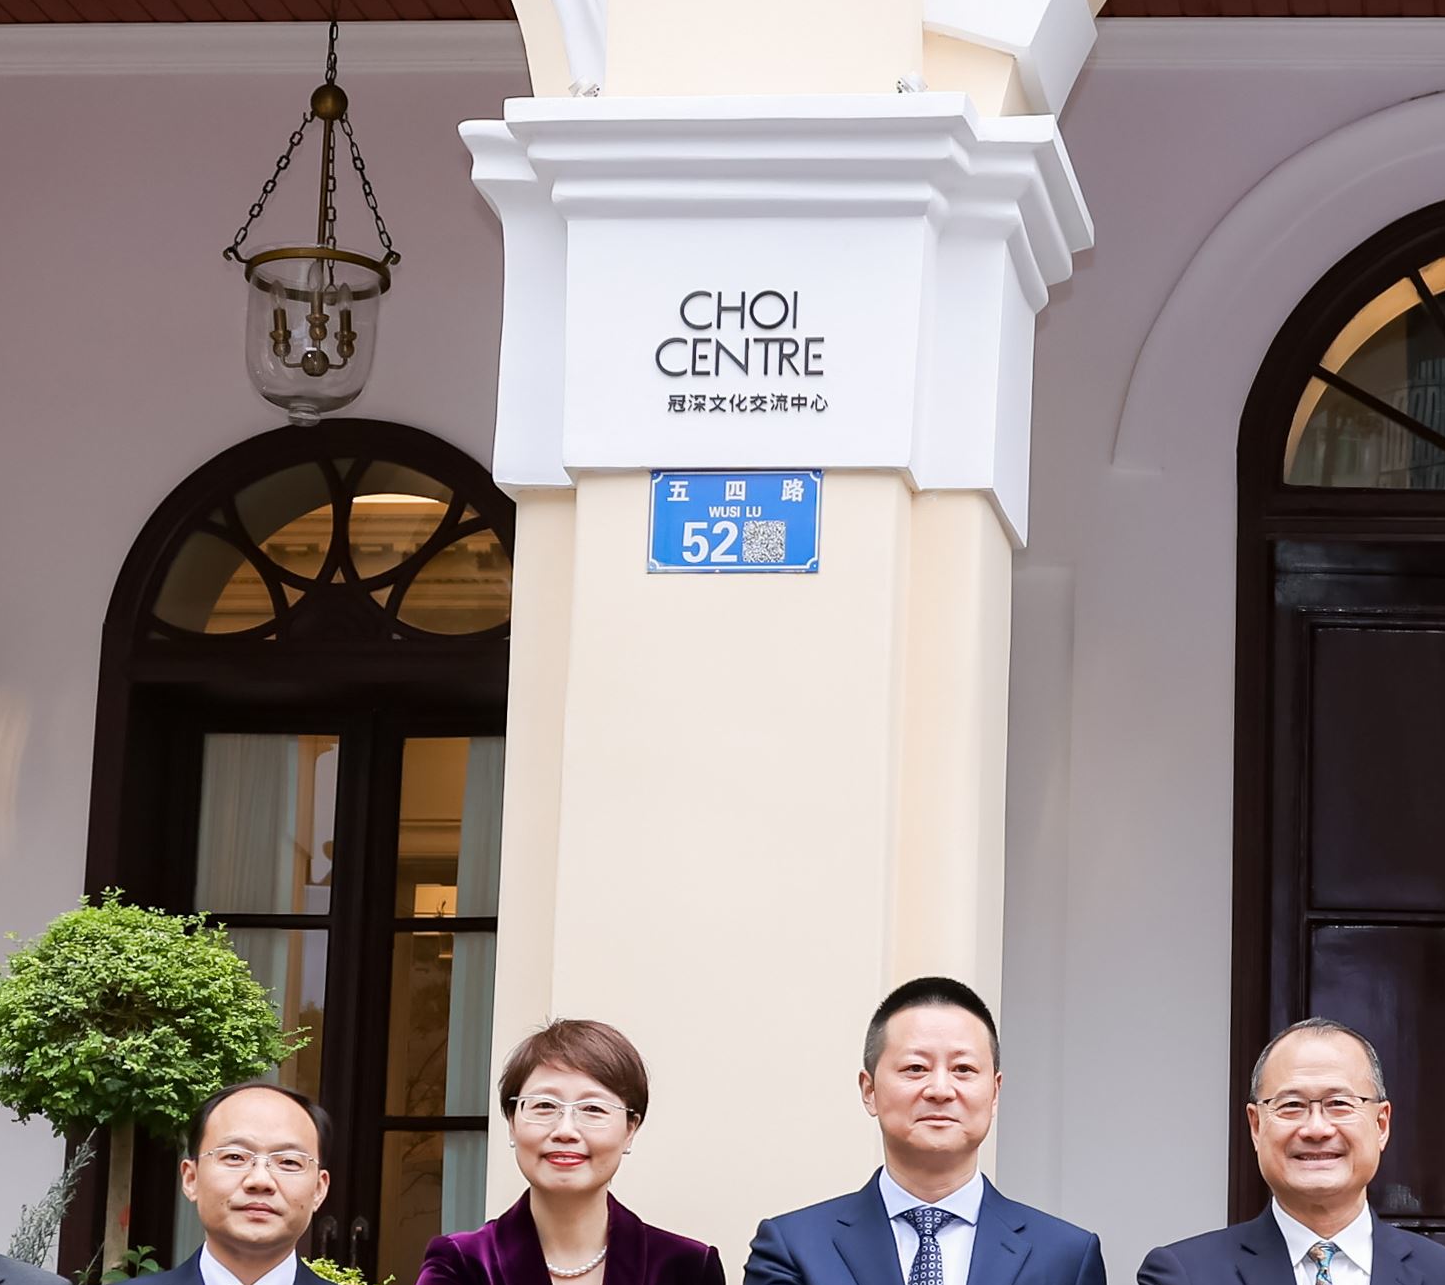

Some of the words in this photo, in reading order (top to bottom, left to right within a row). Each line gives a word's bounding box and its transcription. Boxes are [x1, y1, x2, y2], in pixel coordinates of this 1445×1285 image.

[679, 290, 798, 329] CHOI
[655, 337, 824, 377] CENTRE
[667, 393, 829, 412] 冠深文化交流中心
[666, 478, 805, 503] 五四路
[709, 506, 741, 518] WUSI
[746, 506, 762, 518] LU
[681, 520, 739, 564] 52
